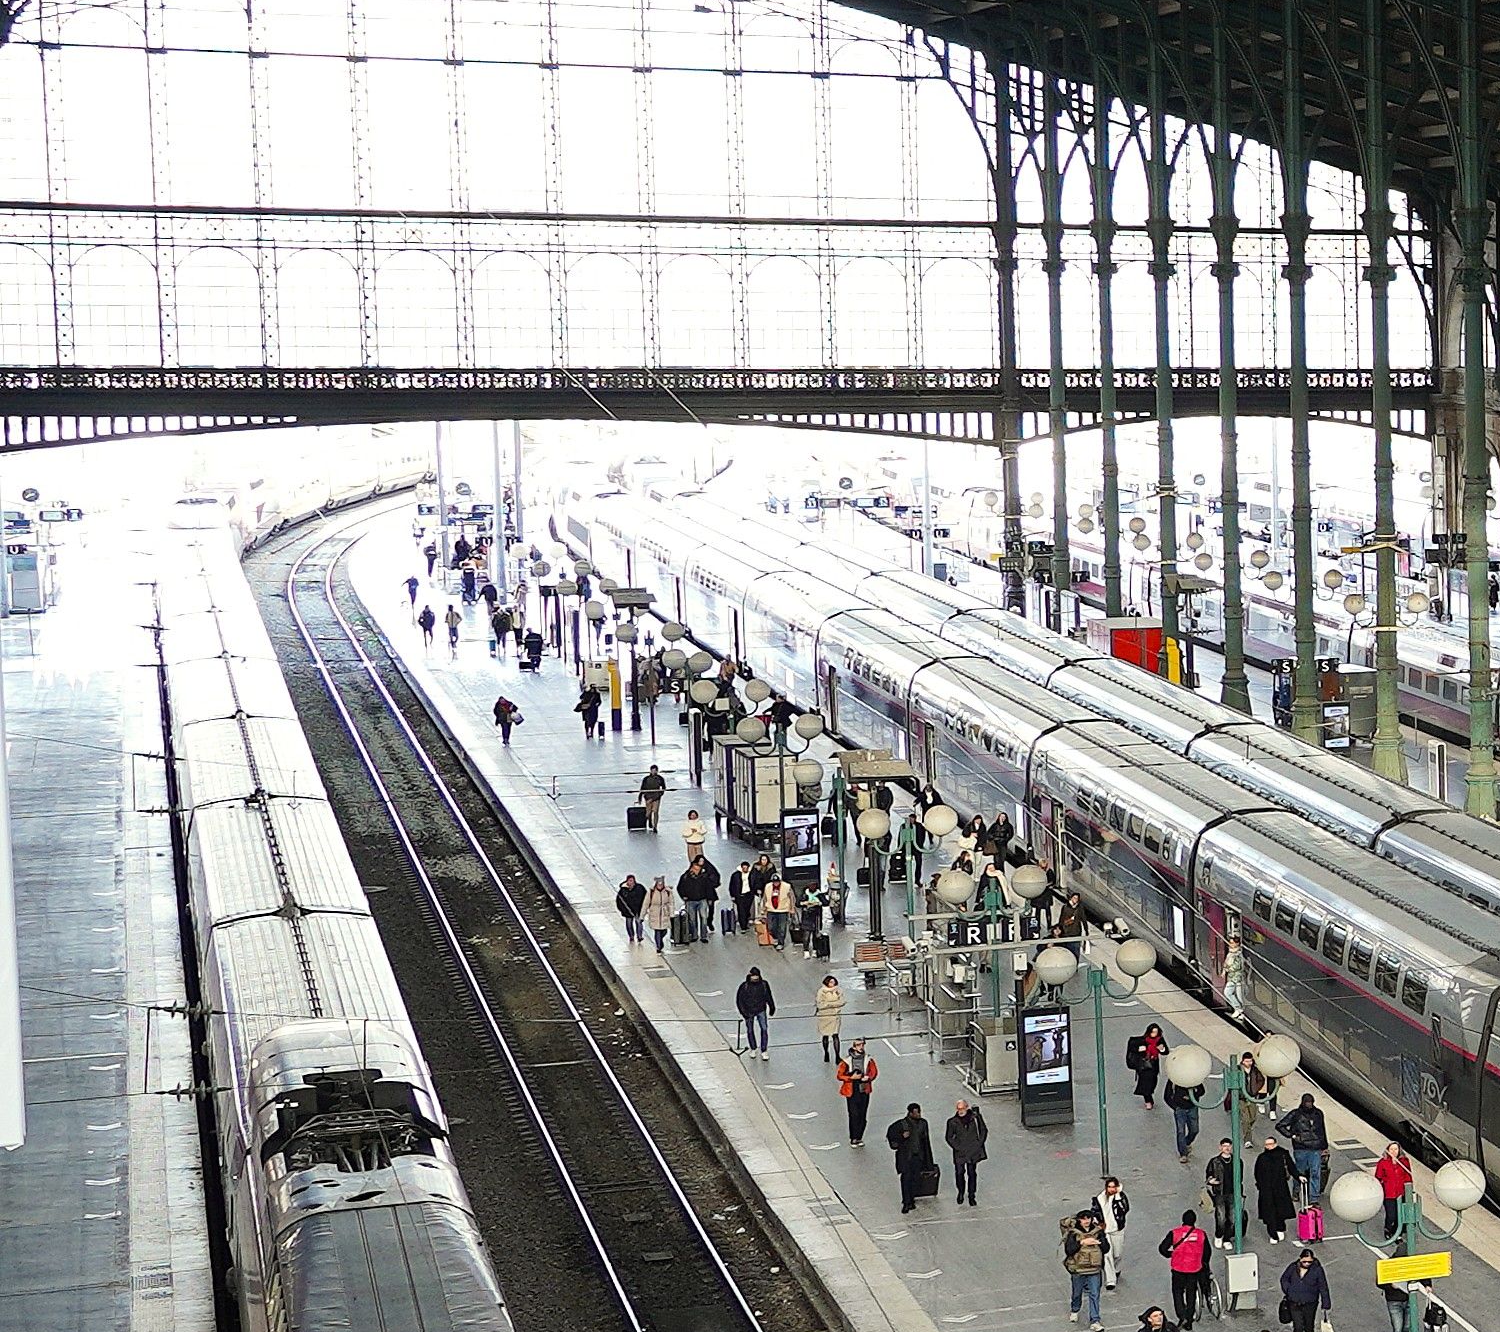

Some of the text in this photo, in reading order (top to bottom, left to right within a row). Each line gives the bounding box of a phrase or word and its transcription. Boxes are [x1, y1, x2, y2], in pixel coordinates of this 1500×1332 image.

[1282, 661, 1291, 672] S
[1321, 661, 1330, 672] S
[670, 680, 679, 693] S
[966, 927, 981, 944] R
